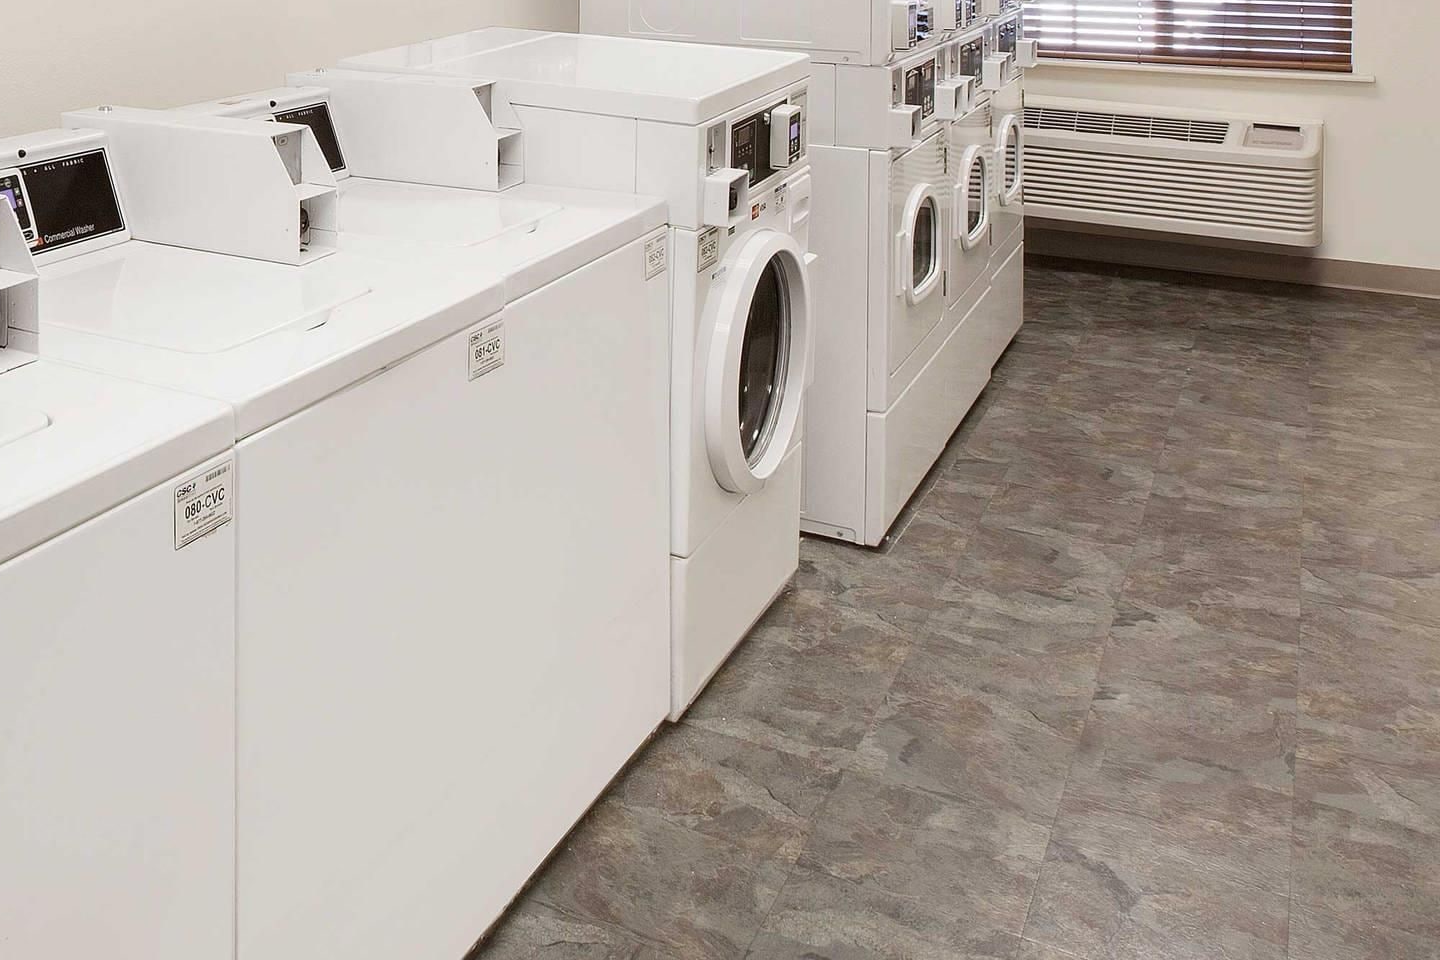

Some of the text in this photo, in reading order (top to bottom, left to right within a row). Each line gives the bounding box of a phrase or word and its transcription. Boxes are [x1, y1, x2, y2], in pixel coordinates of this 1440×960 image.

[44, 223, 95, 244] Commercial Washer
[177, 485, 191, 497] CSC
[185, 488, 225, 519] 080-CVC
